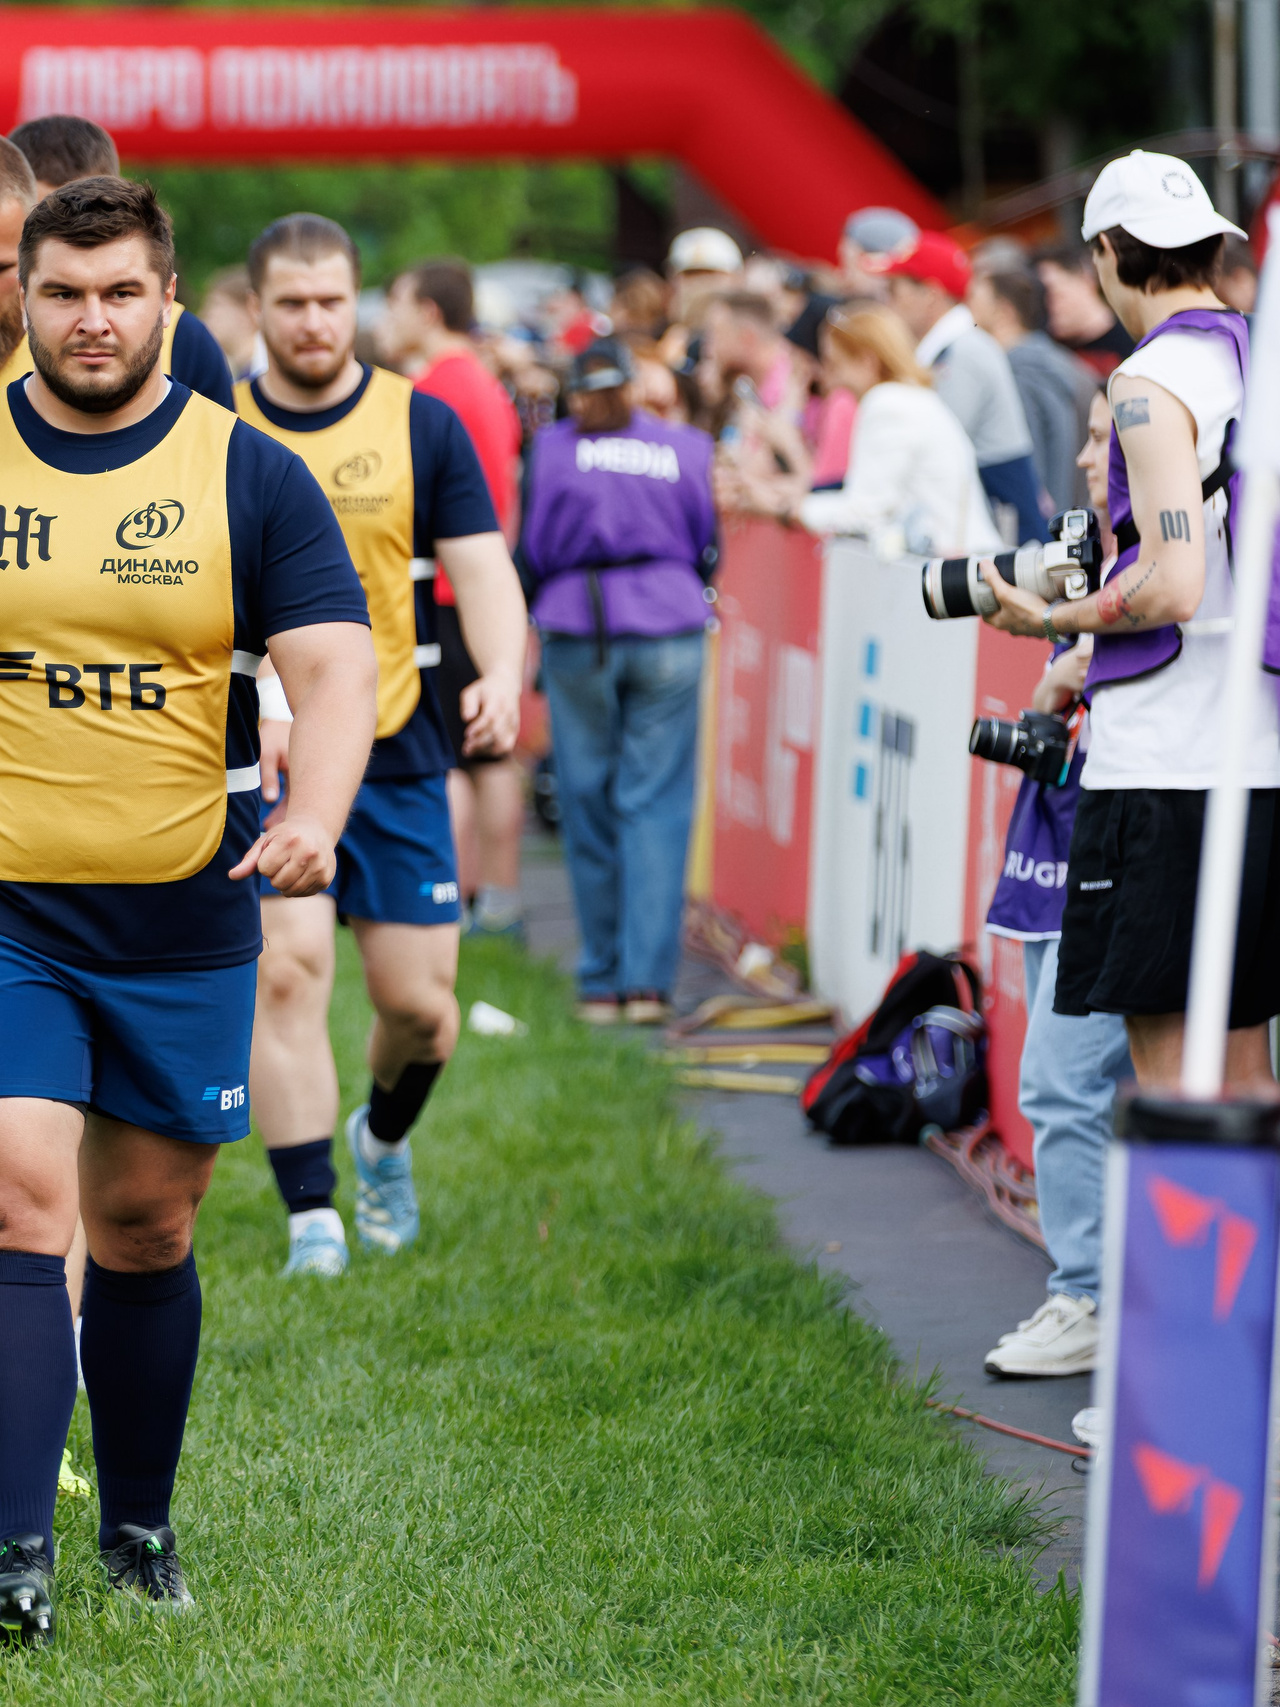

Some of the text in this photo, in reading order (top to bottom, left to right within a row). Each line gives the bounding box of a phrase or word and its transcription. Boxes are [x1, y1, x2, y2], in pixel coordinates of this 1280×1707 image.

[576, 437, 680, 483] MEDIA
[100, 558, 199, 574] ДИНАМО
[117, 574, 184, 585] МОСКВА
[45, 663, 168, 711] ВТБ
[221, 1085, 245, 1110] ВТБ
